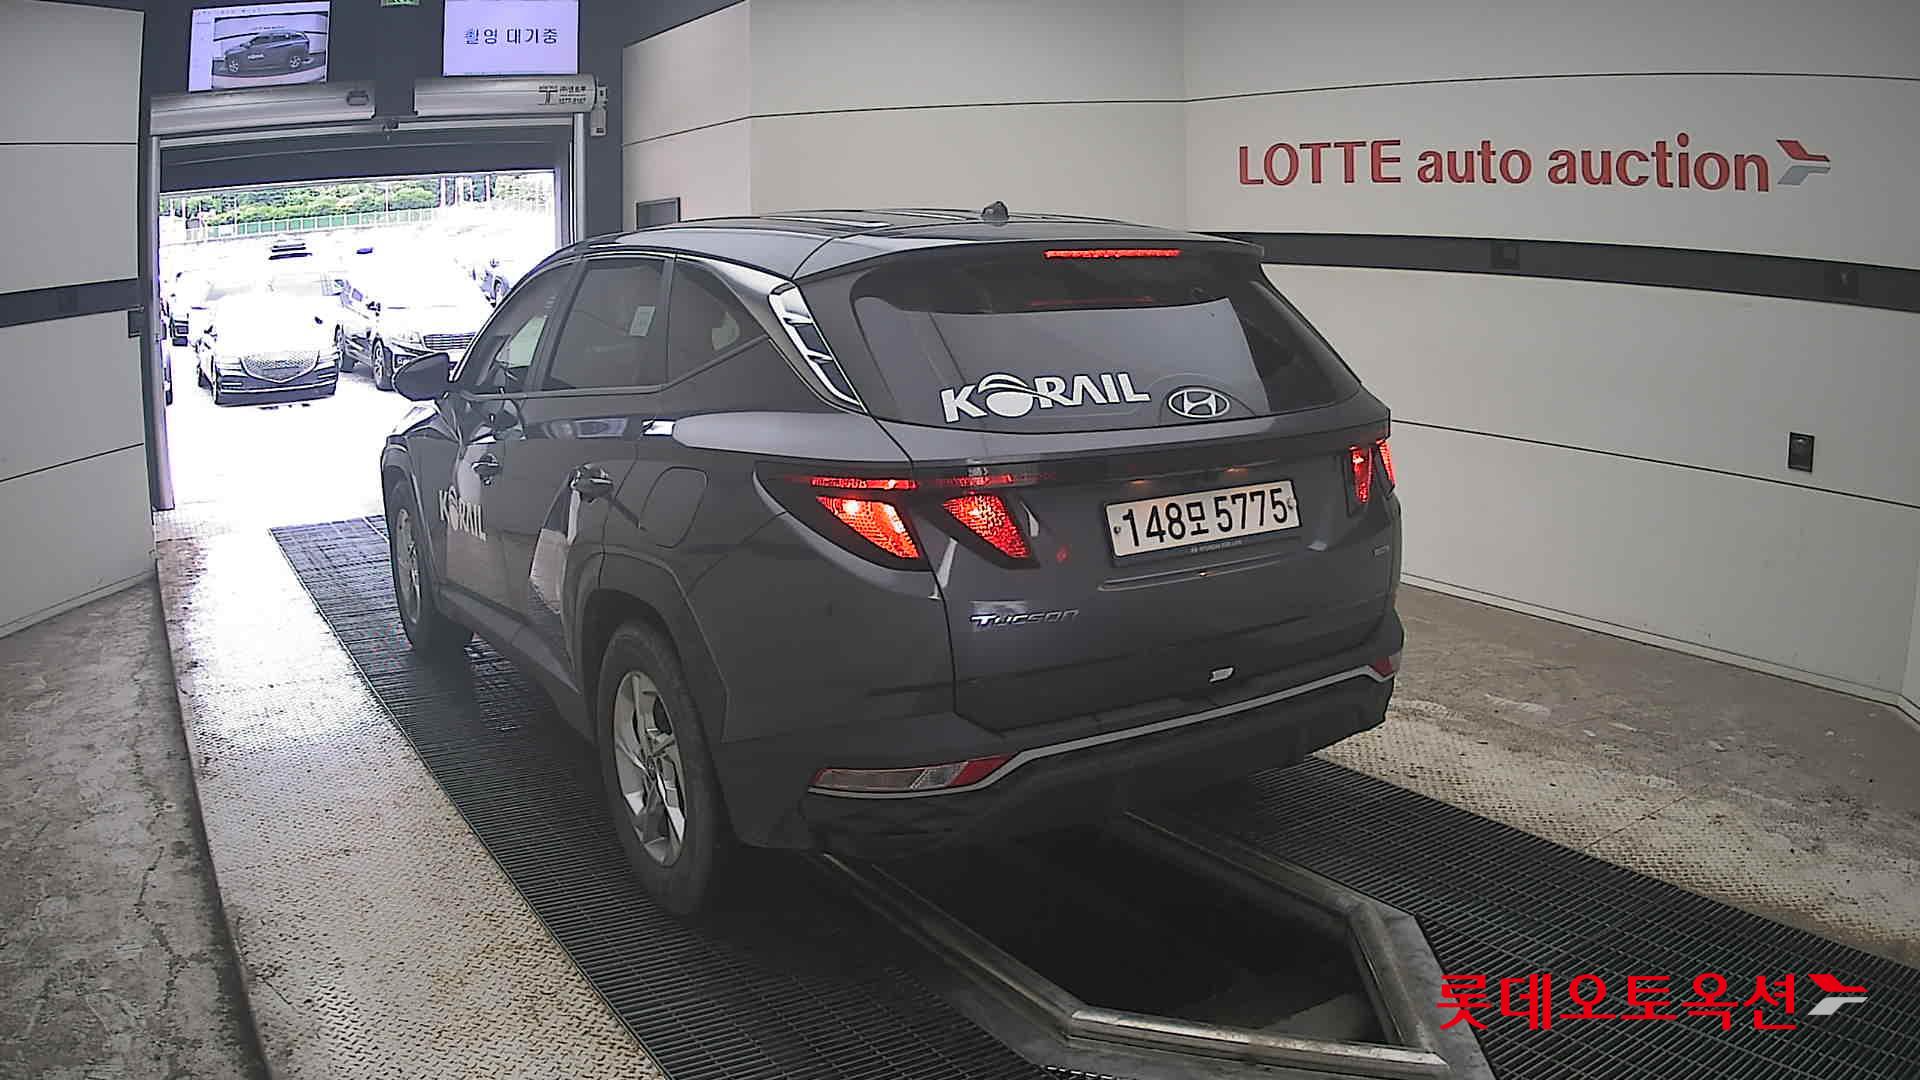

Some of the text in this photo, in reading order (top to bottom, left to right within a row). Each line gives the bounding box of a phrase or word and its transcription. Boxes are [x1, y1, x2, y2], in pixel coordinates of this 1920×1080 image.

[506, 27, 558, 45] 대기중
[1239, 133, 1770, 192] LOTTE auto auction
[940, 373, 1151, 423] KORAIL
[439, 486, 487, 542] KORAIL
[1214, 488, 1287, 532] 5775
